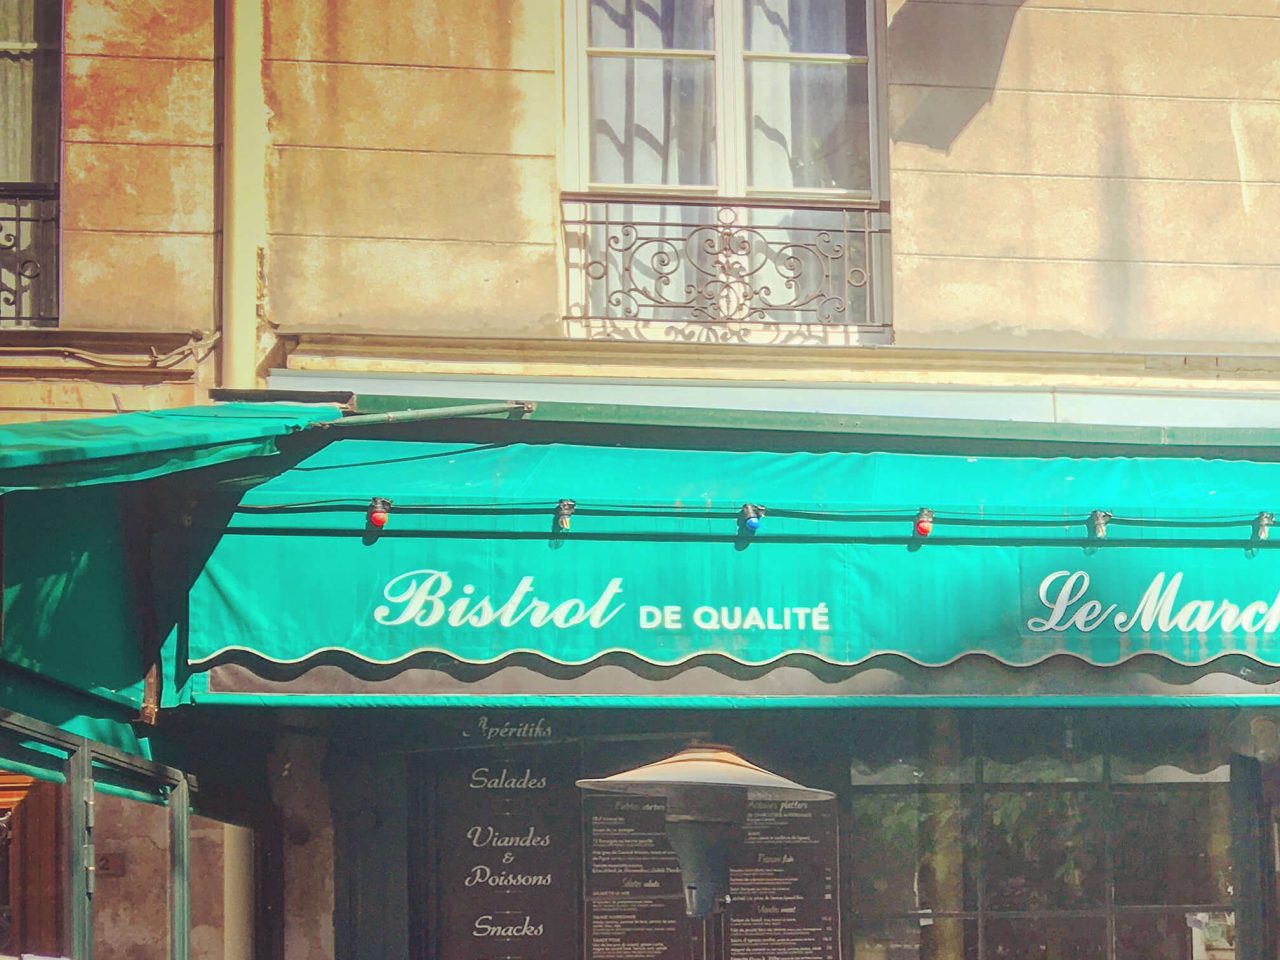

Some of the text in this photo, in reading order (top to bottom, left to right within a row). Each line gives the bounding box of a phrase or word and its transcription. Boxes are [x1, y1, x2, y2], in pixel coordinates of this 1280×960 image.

[373, 569, 831, 630] Bistrot DE QUALITÉ
[1027, 570, 1117, 632] Le
[469, 767, 548, 791] Salades
[467, 826, 550, 849] Viandes
[465, 866, 552, 887] Poissons
[472, 915, 544, 939] Snacks
